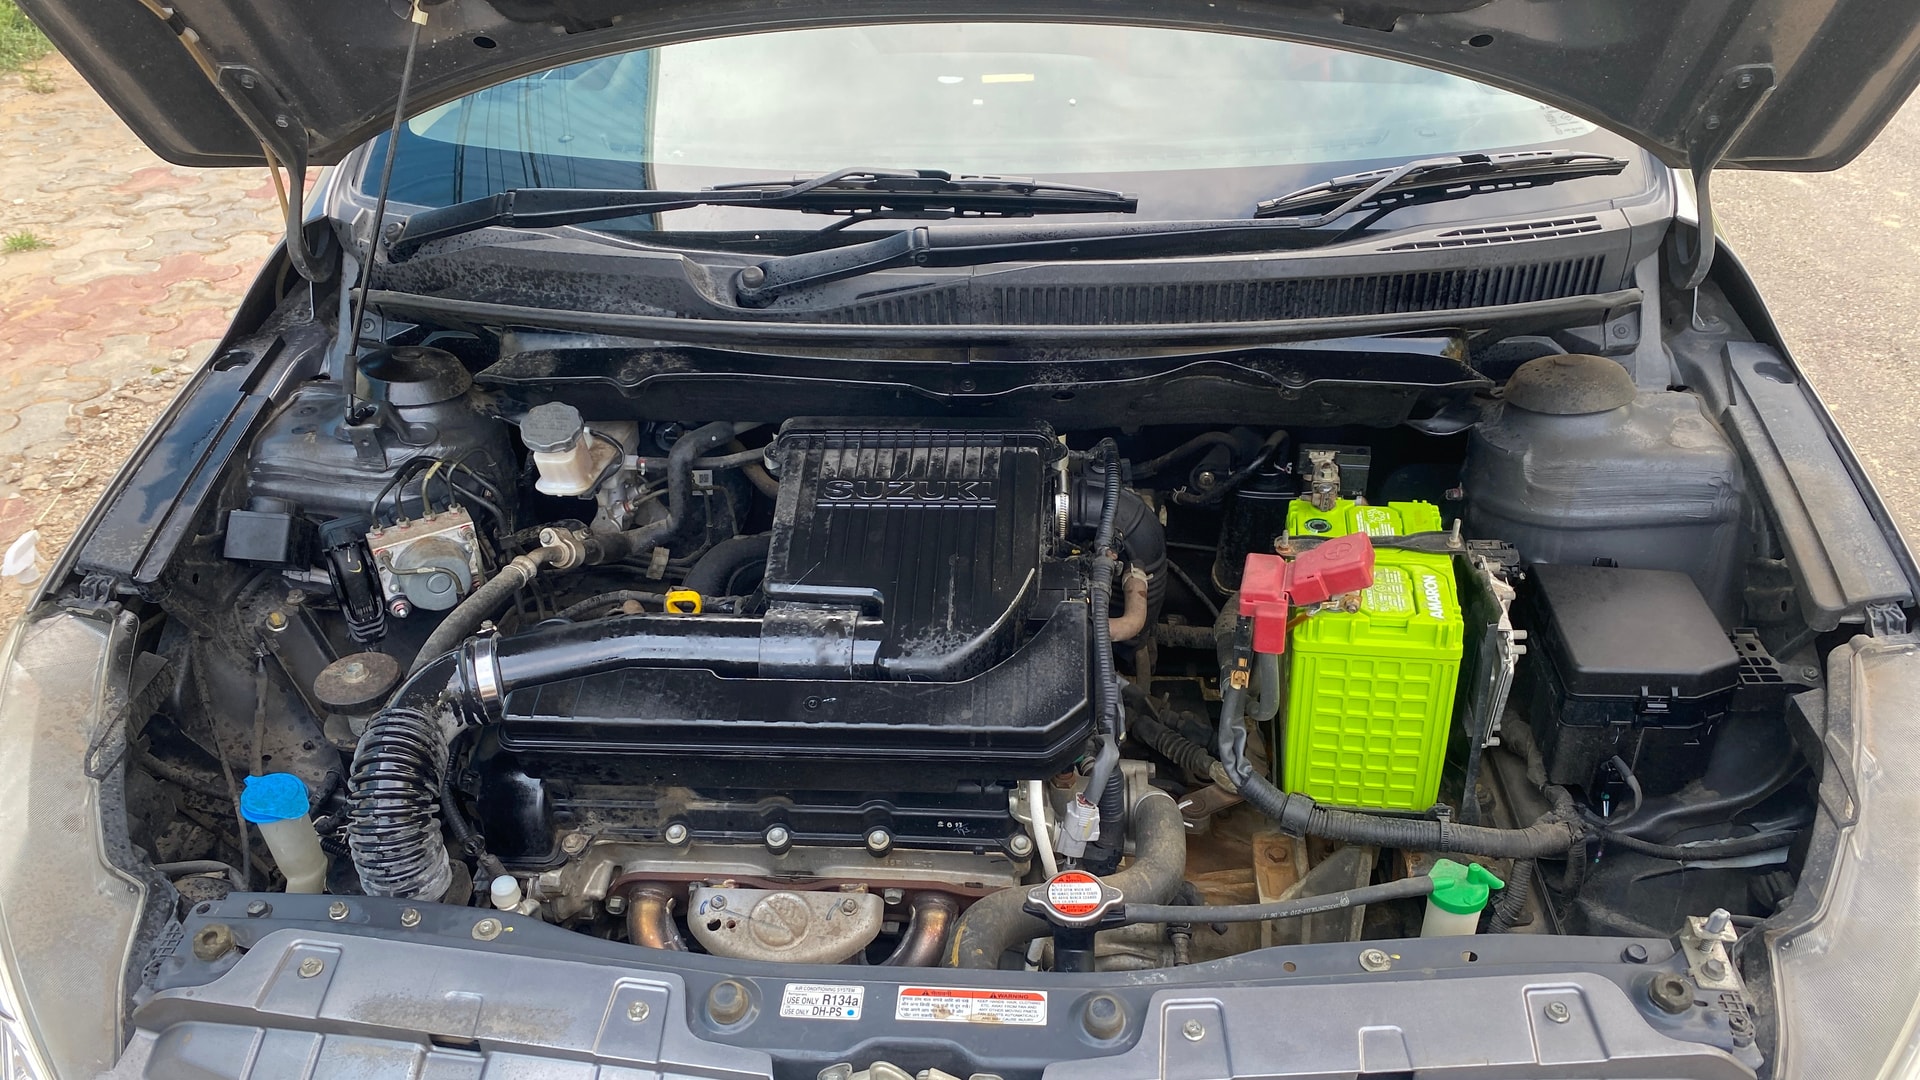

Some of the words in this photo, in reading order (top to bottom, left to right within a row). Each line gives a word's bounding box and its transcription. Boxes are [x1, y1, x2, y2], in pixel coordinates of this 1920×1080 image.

[824, 480, 992, 500] SUZUKI
[1422, 575, 1445, 620] AMARON
[802, 997, 819, 1005] ONLY
[823, 994, 858, 1006] R134a
[812, 1006, 842, 1017] DH-PS
